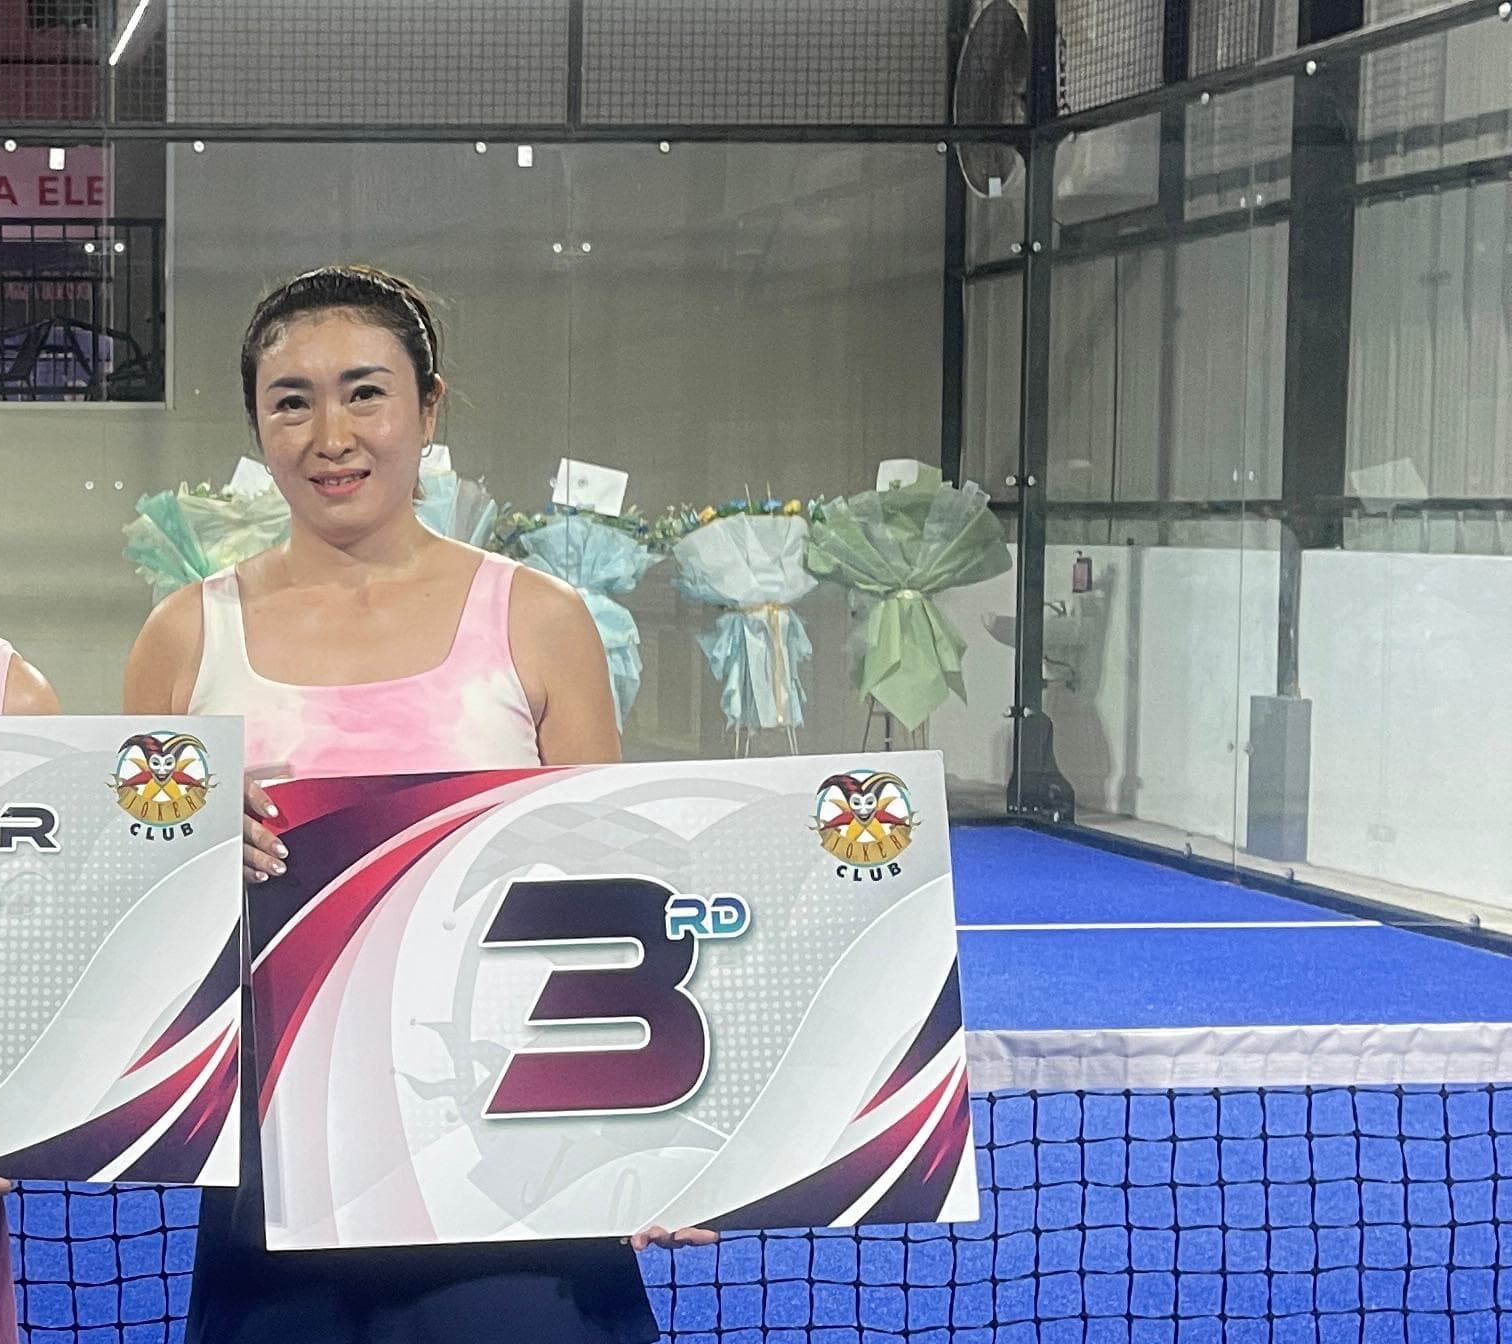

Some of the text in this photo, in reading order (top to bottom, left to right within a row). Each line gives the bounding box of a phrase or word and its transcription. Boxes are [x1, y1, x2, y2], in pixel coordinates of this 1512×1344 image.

[126, 795, 198, 822] JOKER
[129, 822, 194, 841] CLUB
[831, 834, 904, 863] JOKER
[835, 862, 903, 883] CLUB
